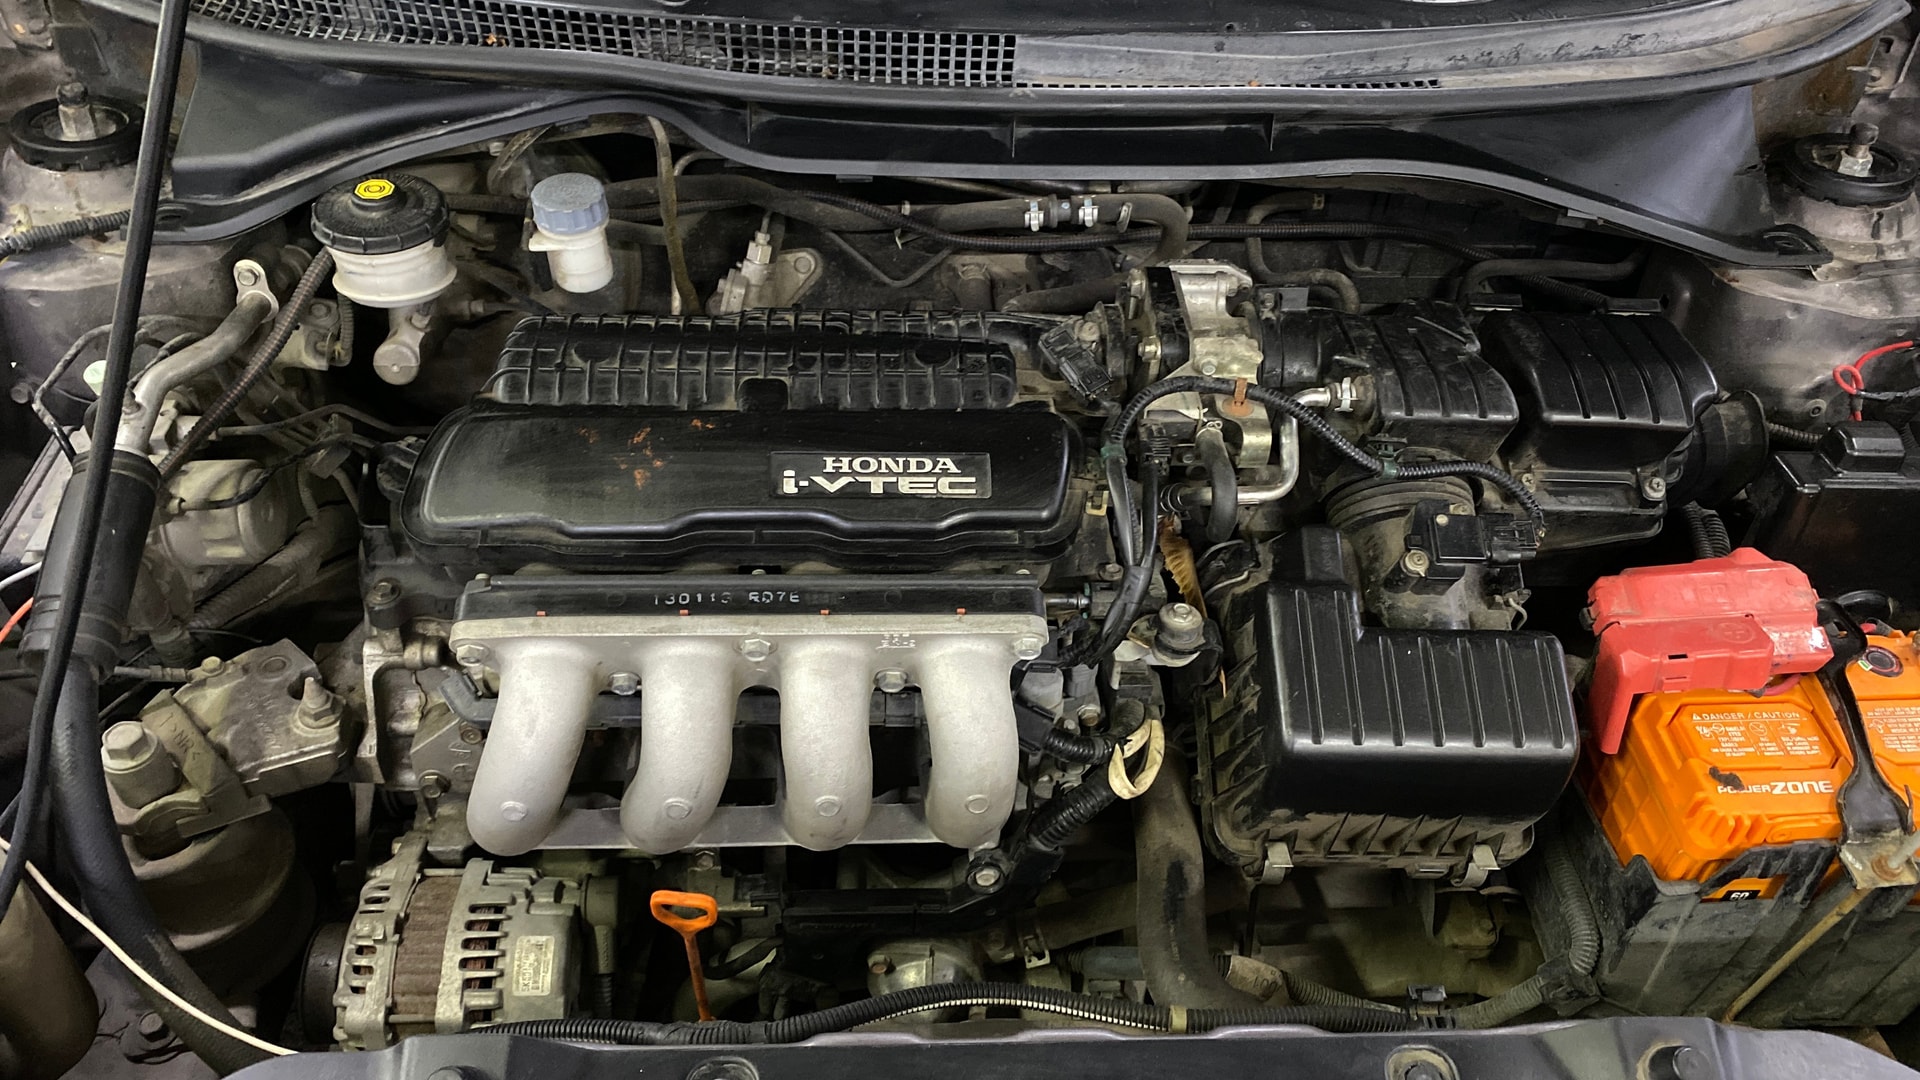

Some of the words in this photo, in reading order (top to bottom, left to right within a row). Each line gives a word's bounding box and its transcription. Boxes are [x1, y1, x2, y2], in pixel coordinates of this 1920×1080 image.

[822, 457, 962, 473] HONDA
[782, 469, 977, 494] i-VTEC
[1702, 712, 1745, 720] DANGER
[1753, 711, 1800, 719] CAUTION
